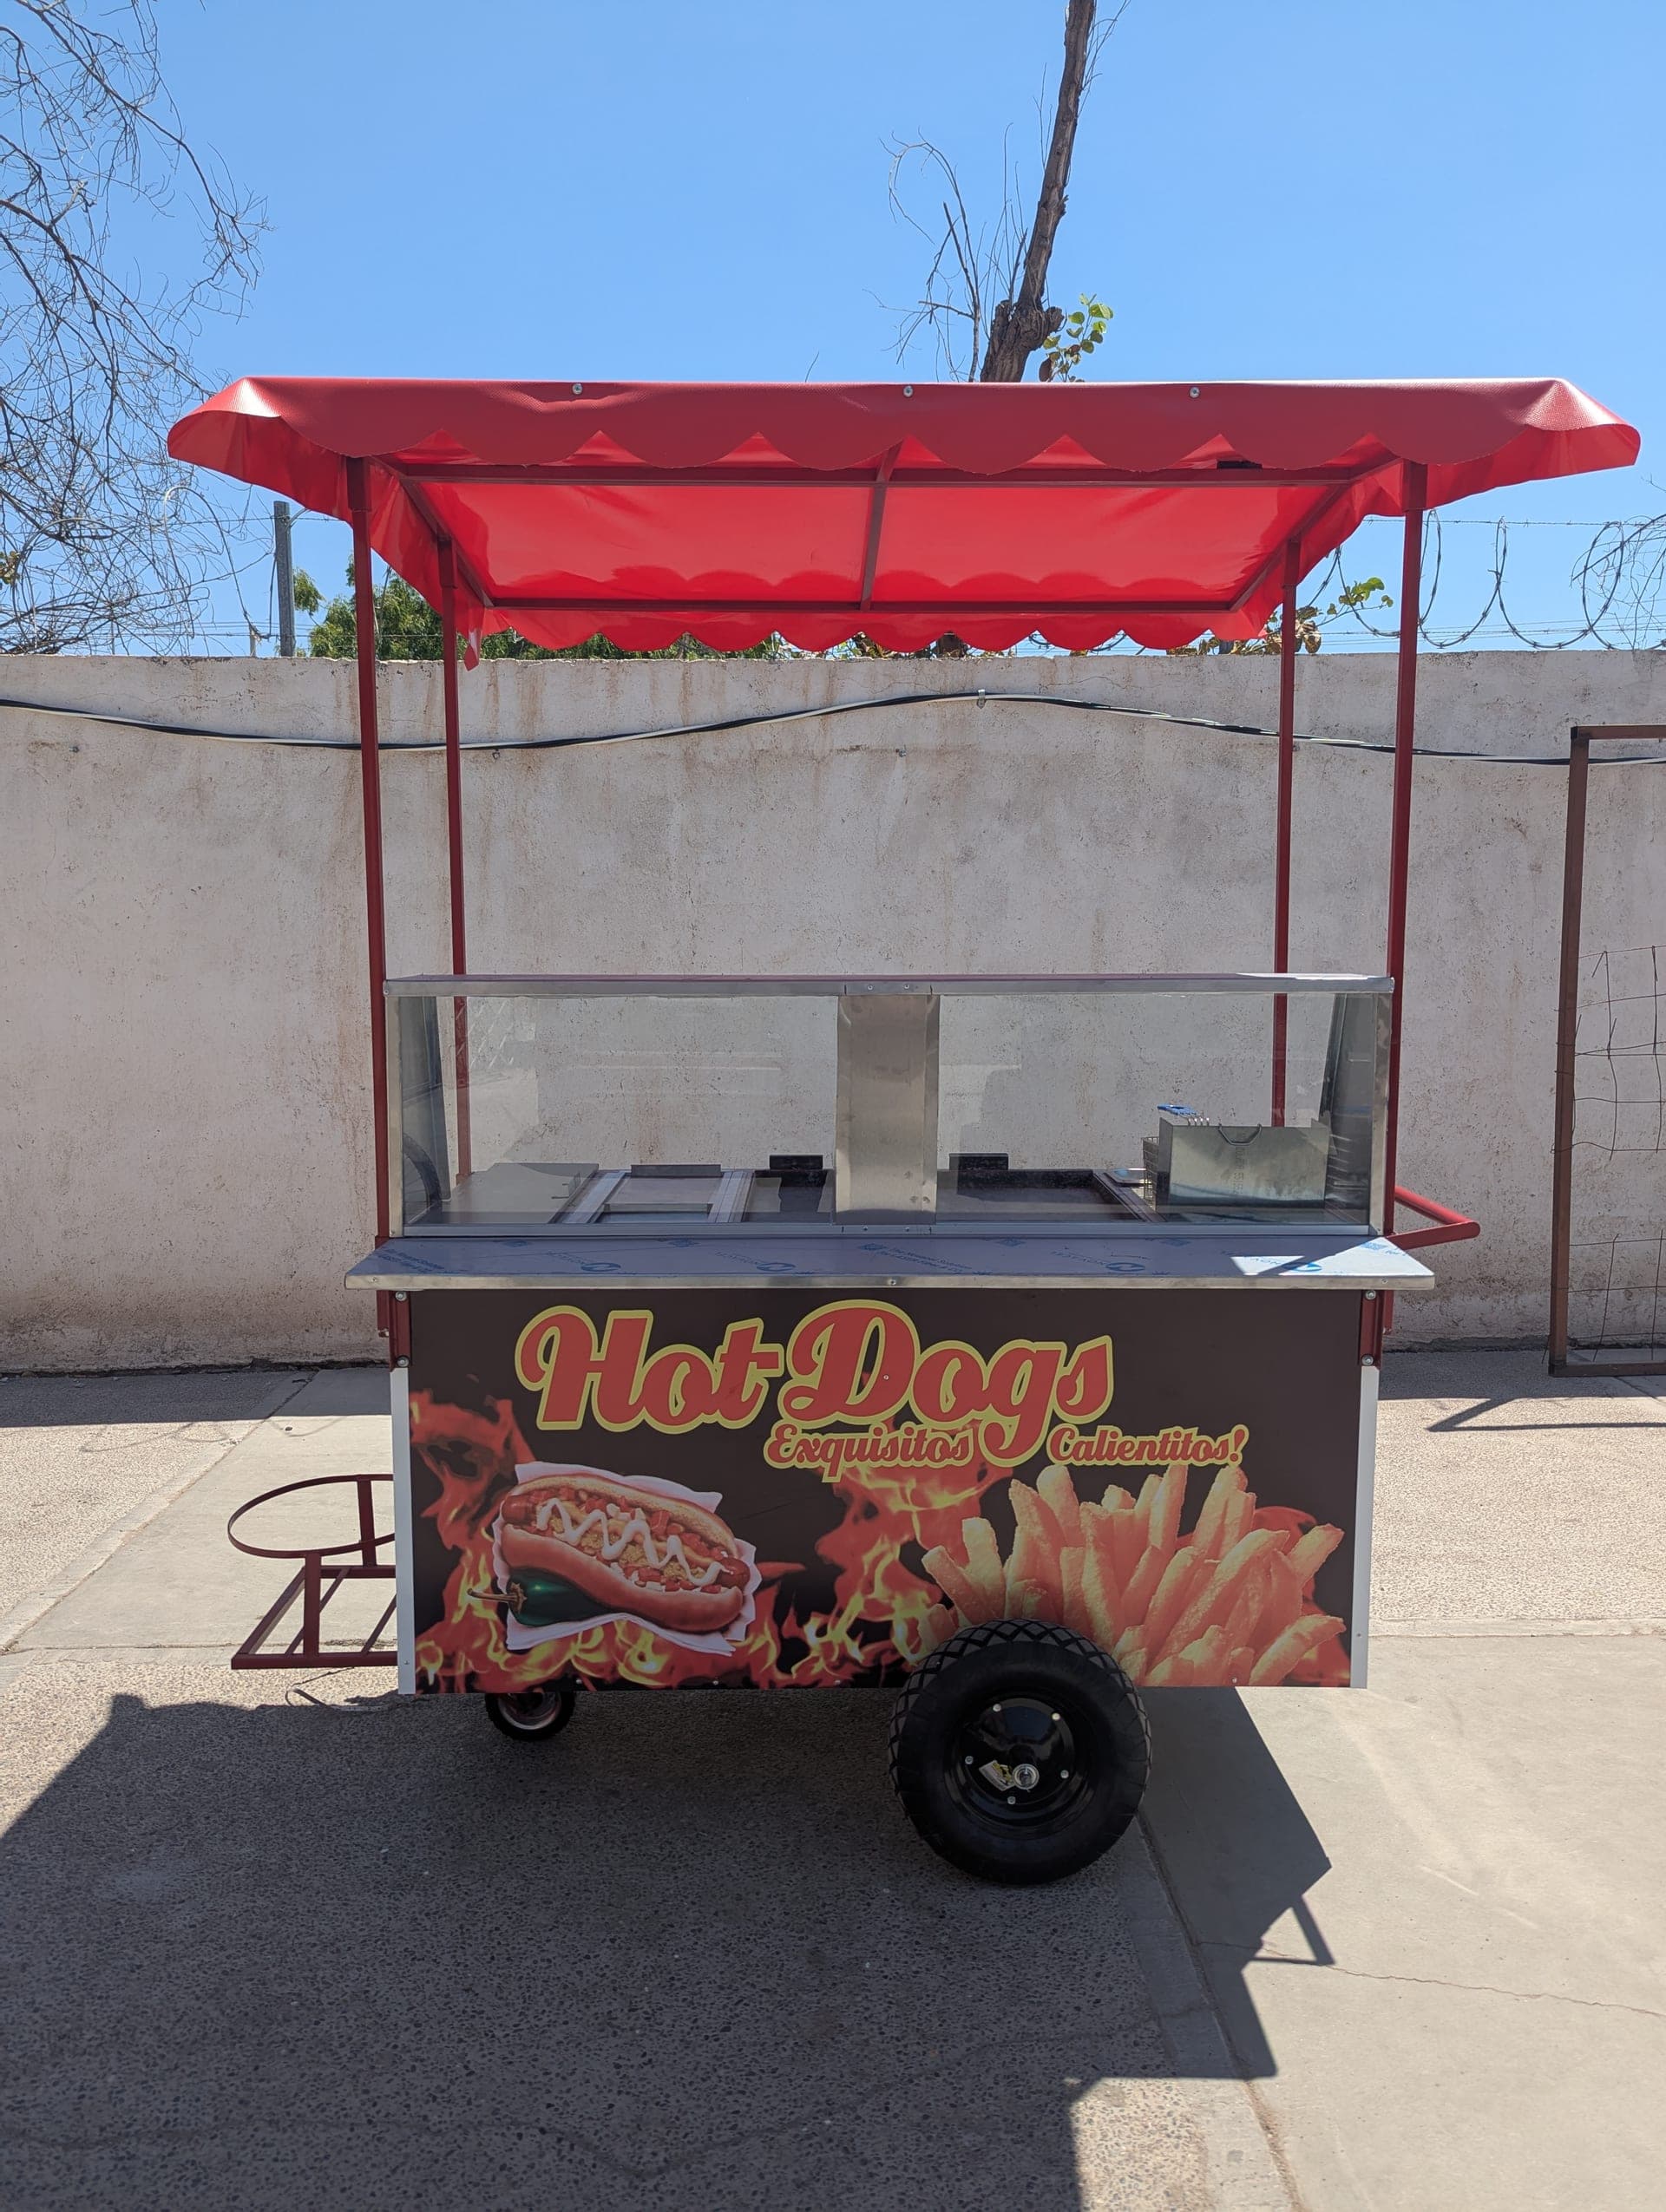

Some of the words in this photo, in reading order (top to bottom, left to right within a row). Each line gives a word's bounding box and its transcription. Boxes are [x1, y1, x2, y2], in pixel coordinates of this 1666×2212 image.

[515, 1306, 784, 1434] Hot
[777, 1300, 1113, 1466] Dogs
[764, 1423, 974, 1482] Exquisitos
[1046, 1423, 1249, 1467] Calientitos!
